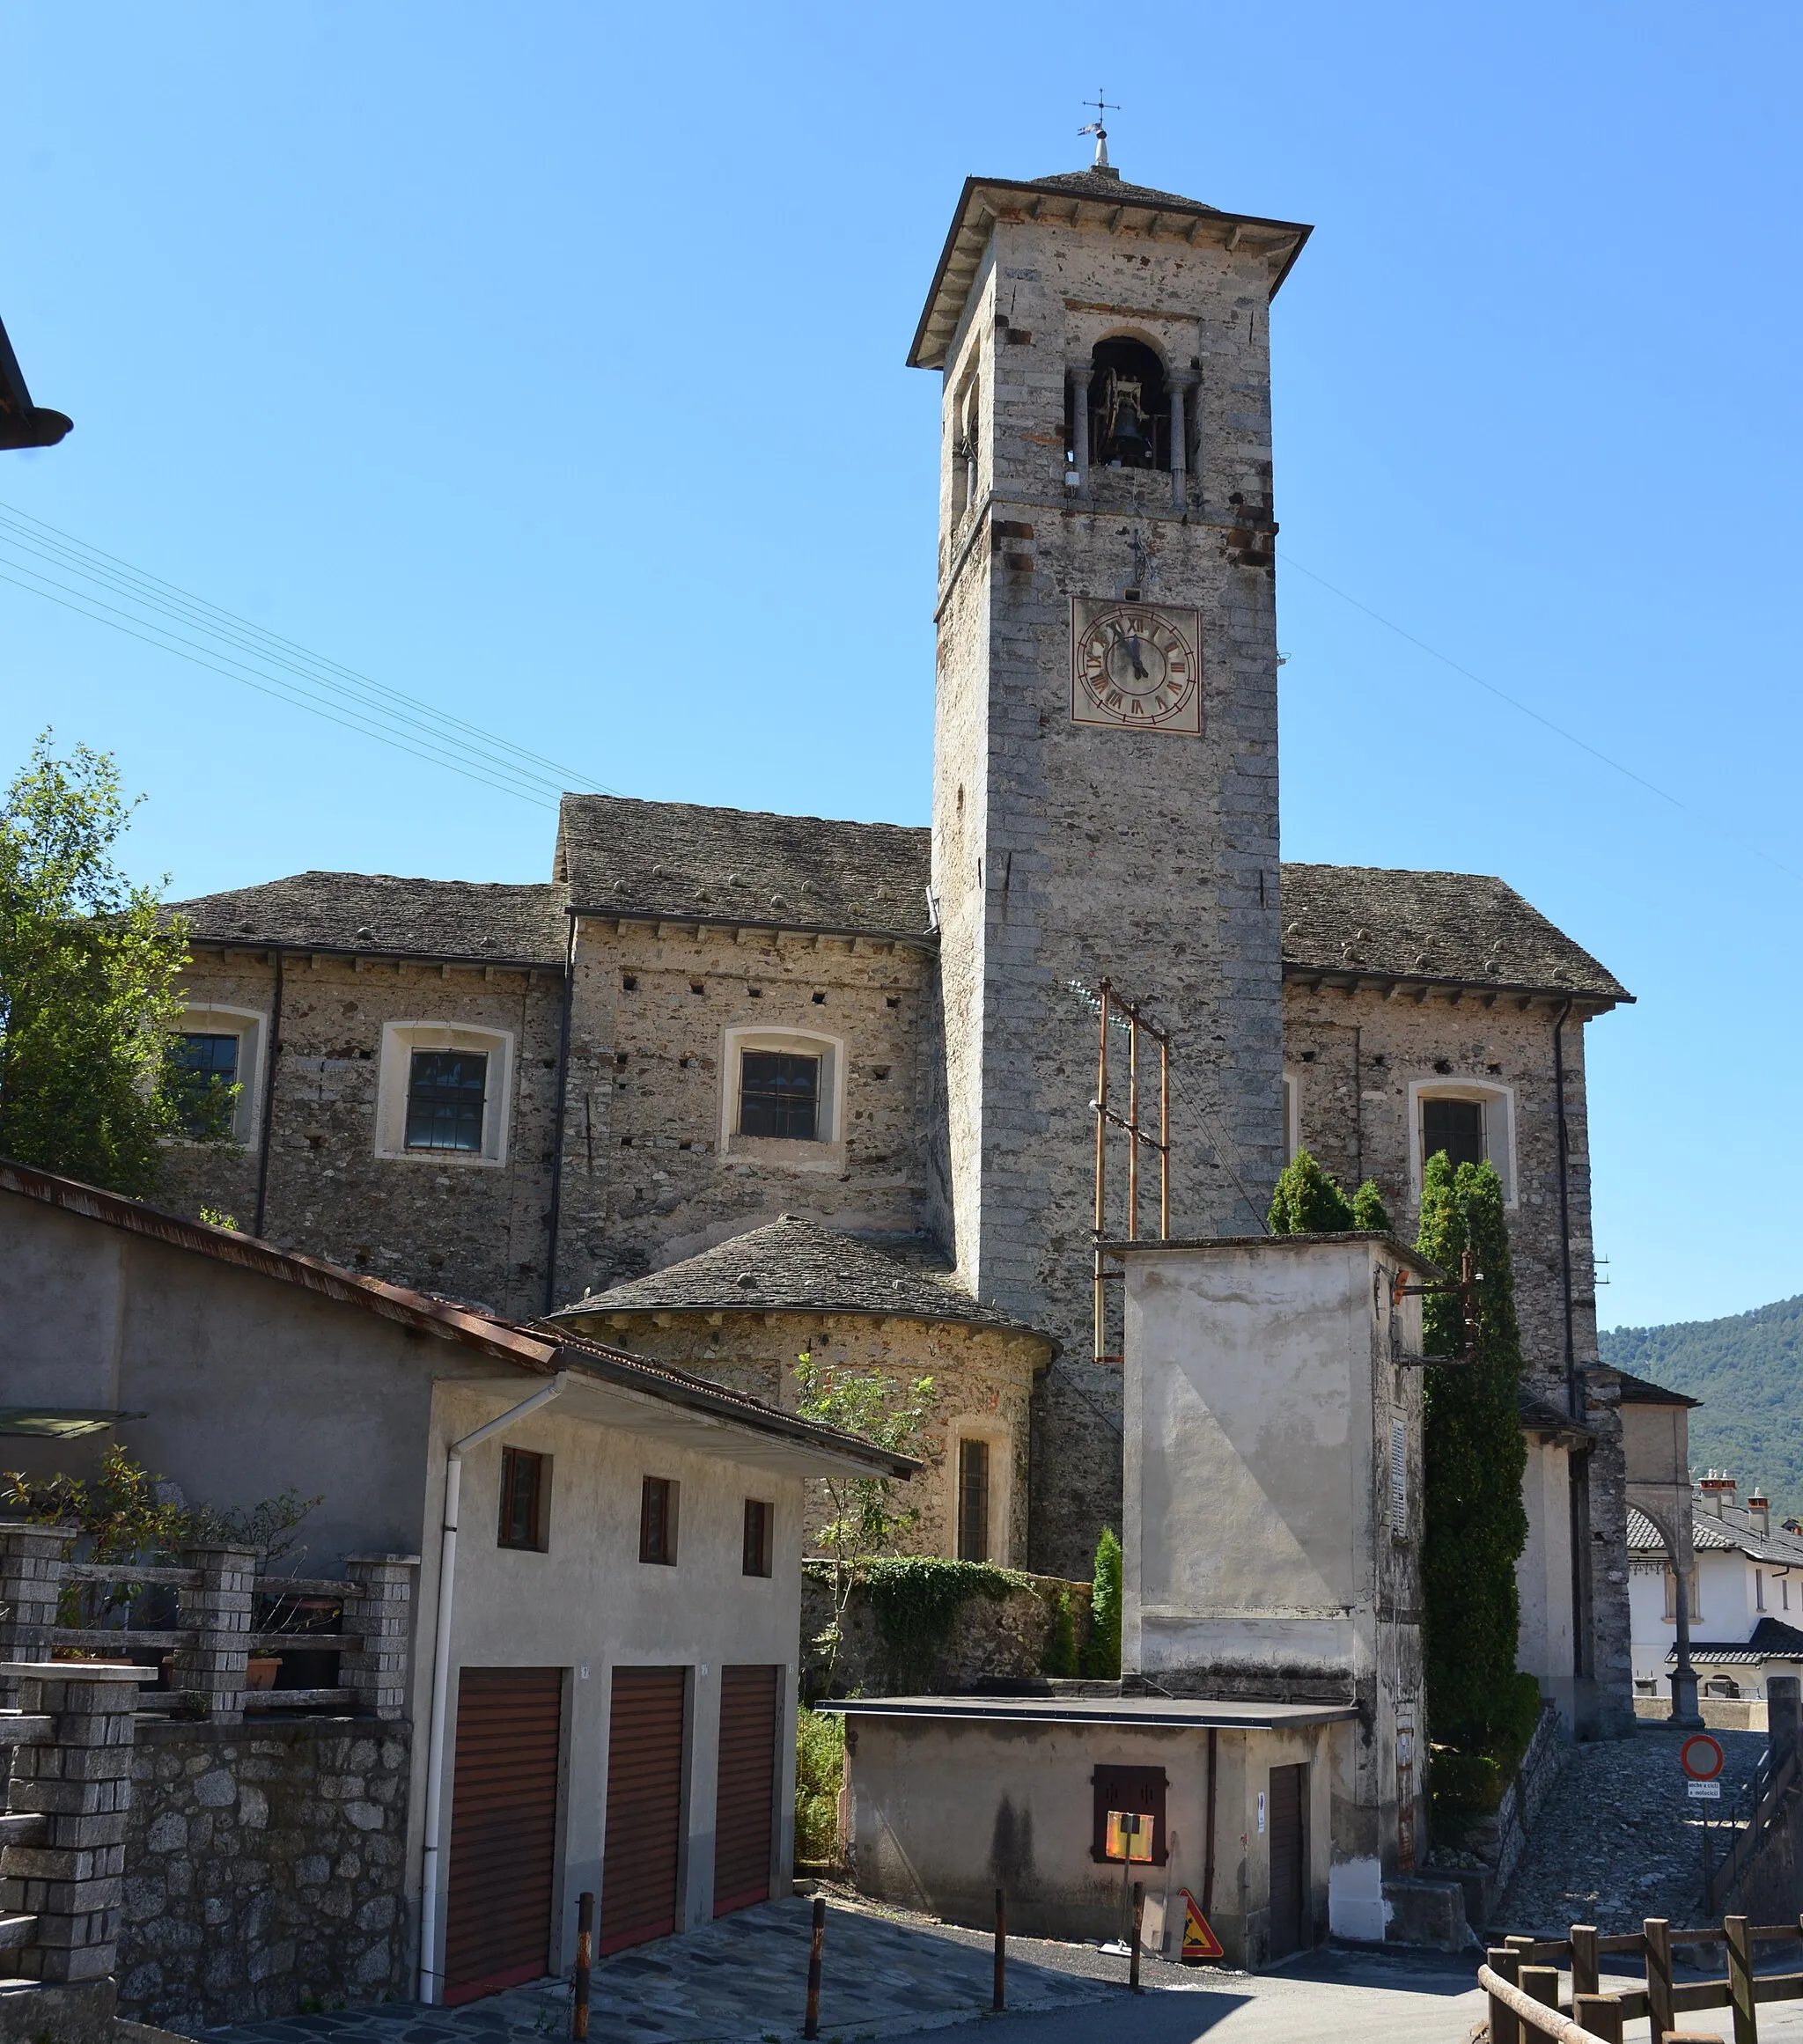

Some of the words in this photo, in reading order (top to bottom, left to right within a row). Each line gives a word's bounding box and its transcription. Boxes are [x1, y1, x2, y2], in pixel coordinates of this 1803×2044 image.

[1127, 617, 1144, 633] XII
[1086, 654, 1101, 668] IX
[1171, 662, 1185, 673] III
[1107, 689, 1123, 710] VII
[1131, 699, 1144, 714] VI
[1155, 695, 1168, 710] V
